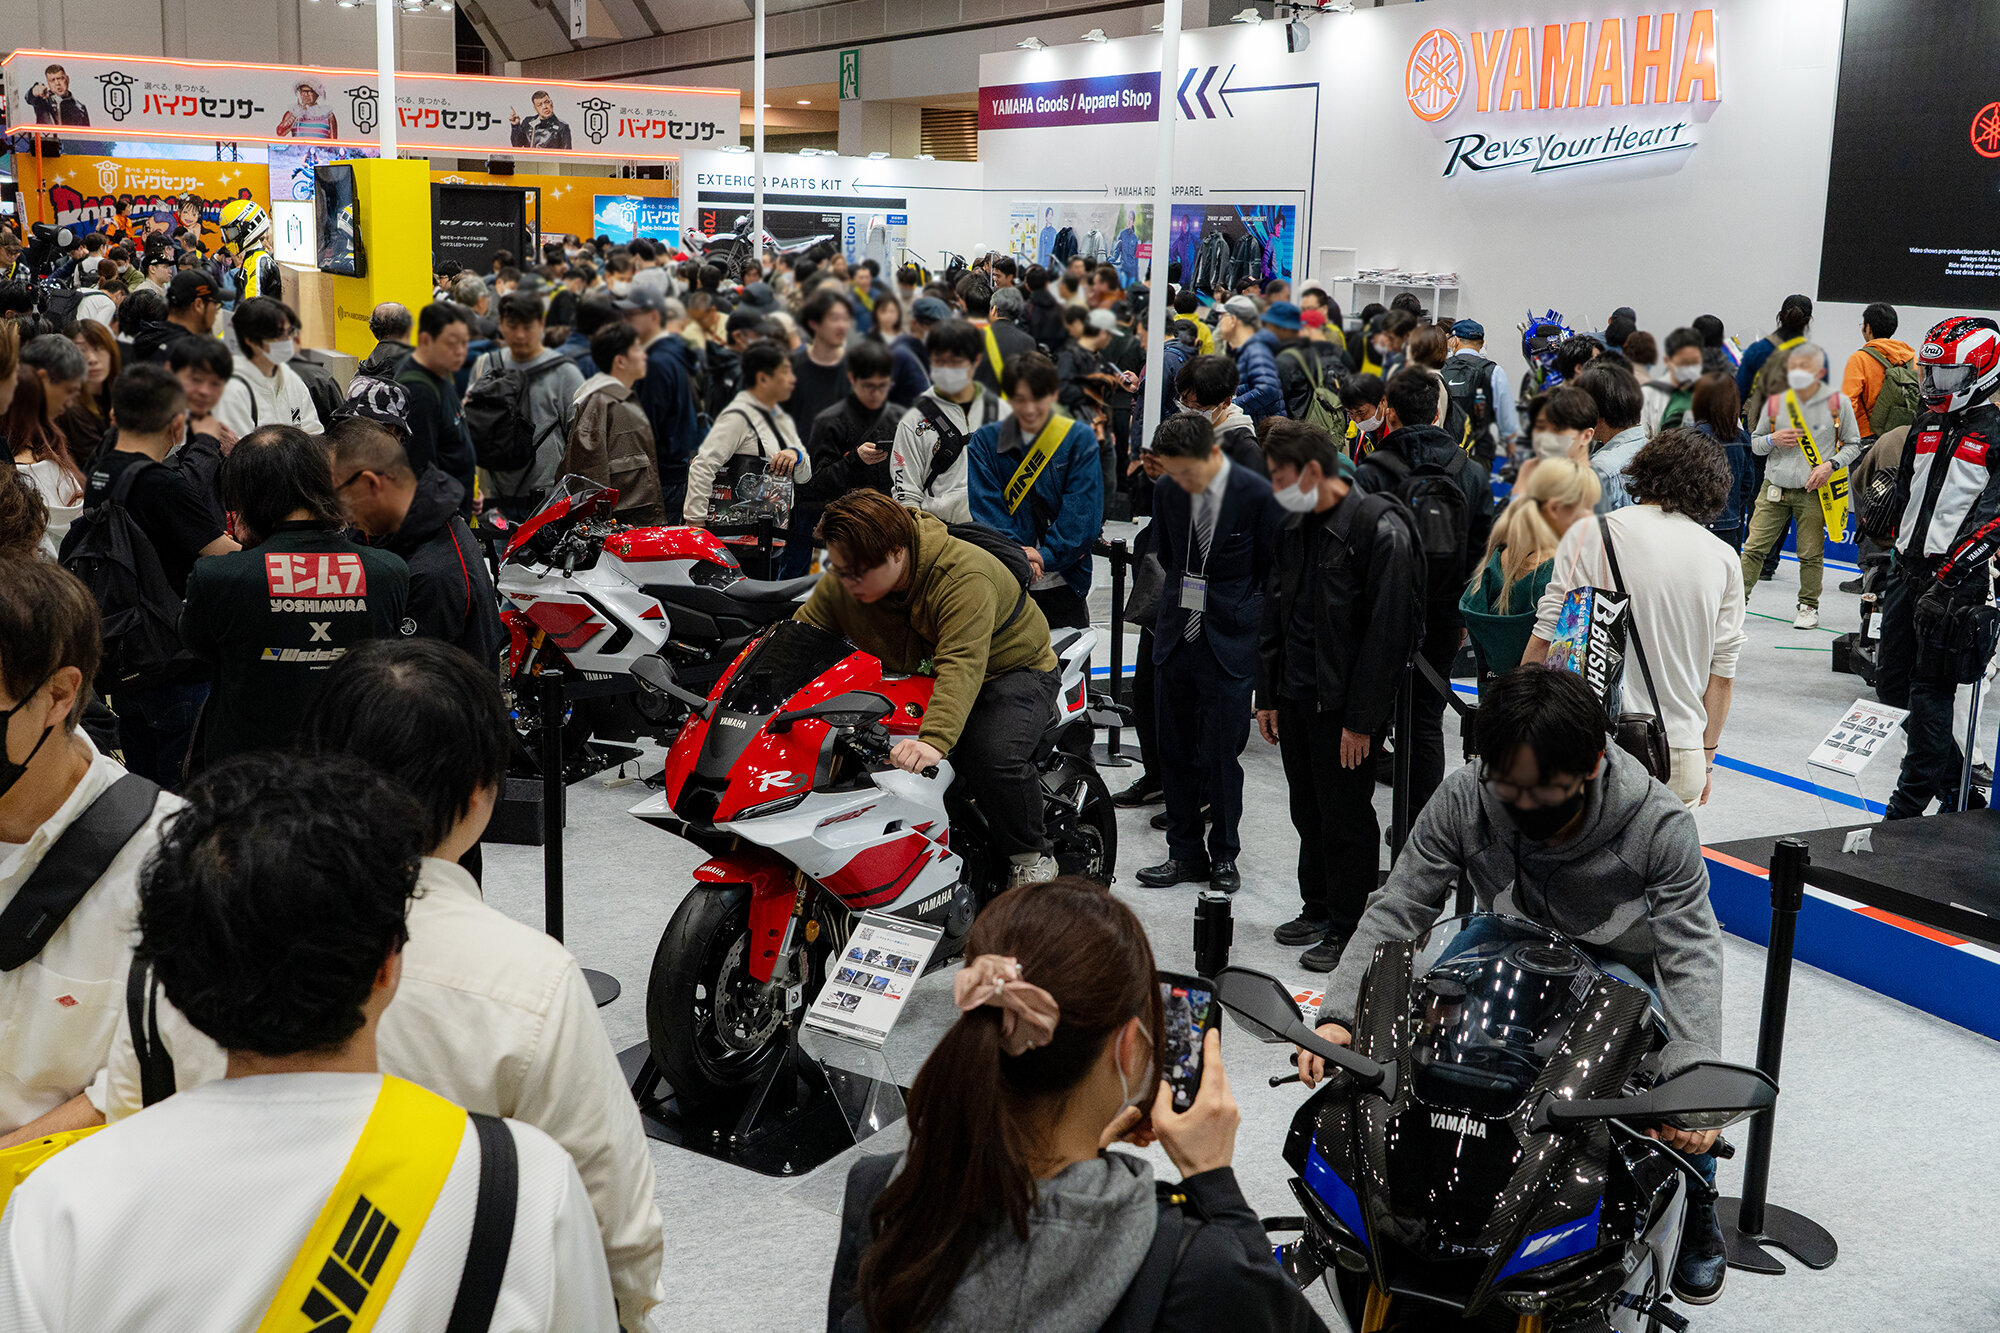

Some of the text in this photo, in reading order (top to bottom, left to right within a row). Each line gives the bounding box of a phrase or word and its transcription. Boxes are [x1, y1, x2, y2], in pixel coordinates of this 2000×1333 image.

[1470, 9, 1718, 113] YAMAHA
[144, 82, 210, 94] 選べる、見つかる。
[143, 94, 265, 119] バイクセンサー
[395, 96, 451, 106] べる、見つかる。
[992, 89, 1152, 116] YAMAHA Goods / Apparel Shop
[620, 107, 678, 117] 選べる、見つかる。
[618, 118, 725, 140] バイクセンサー
[1442, 121, 1692, 178] Revs Your Heart
[124, 175, 204, 191] バイクセンサー
[772, 177, 816, 190] PARTS
[822, 179, 842, 190] KIT
[1114, 186, 1142, 197] YAMAHA
[1871, 479, 1887, 496] USA
[1966, 542, 1990, 562] YAMAHA
[268, 555, 362, 595] ヨシムラ
[270, 598, 367, 613] YOSHIMURA
[309, 622, 332, 642] X
[583, 671, 613, 681] YAMAHA
[719, 716, 747, 730] YAMAHA
[755, 770, 809, 792] R9
[697, 865, 726, 878] YAMAHA
[917, 888, 953, 916] YAMAHA
[1430, 1112, 1487, 1139] YAMAHA
